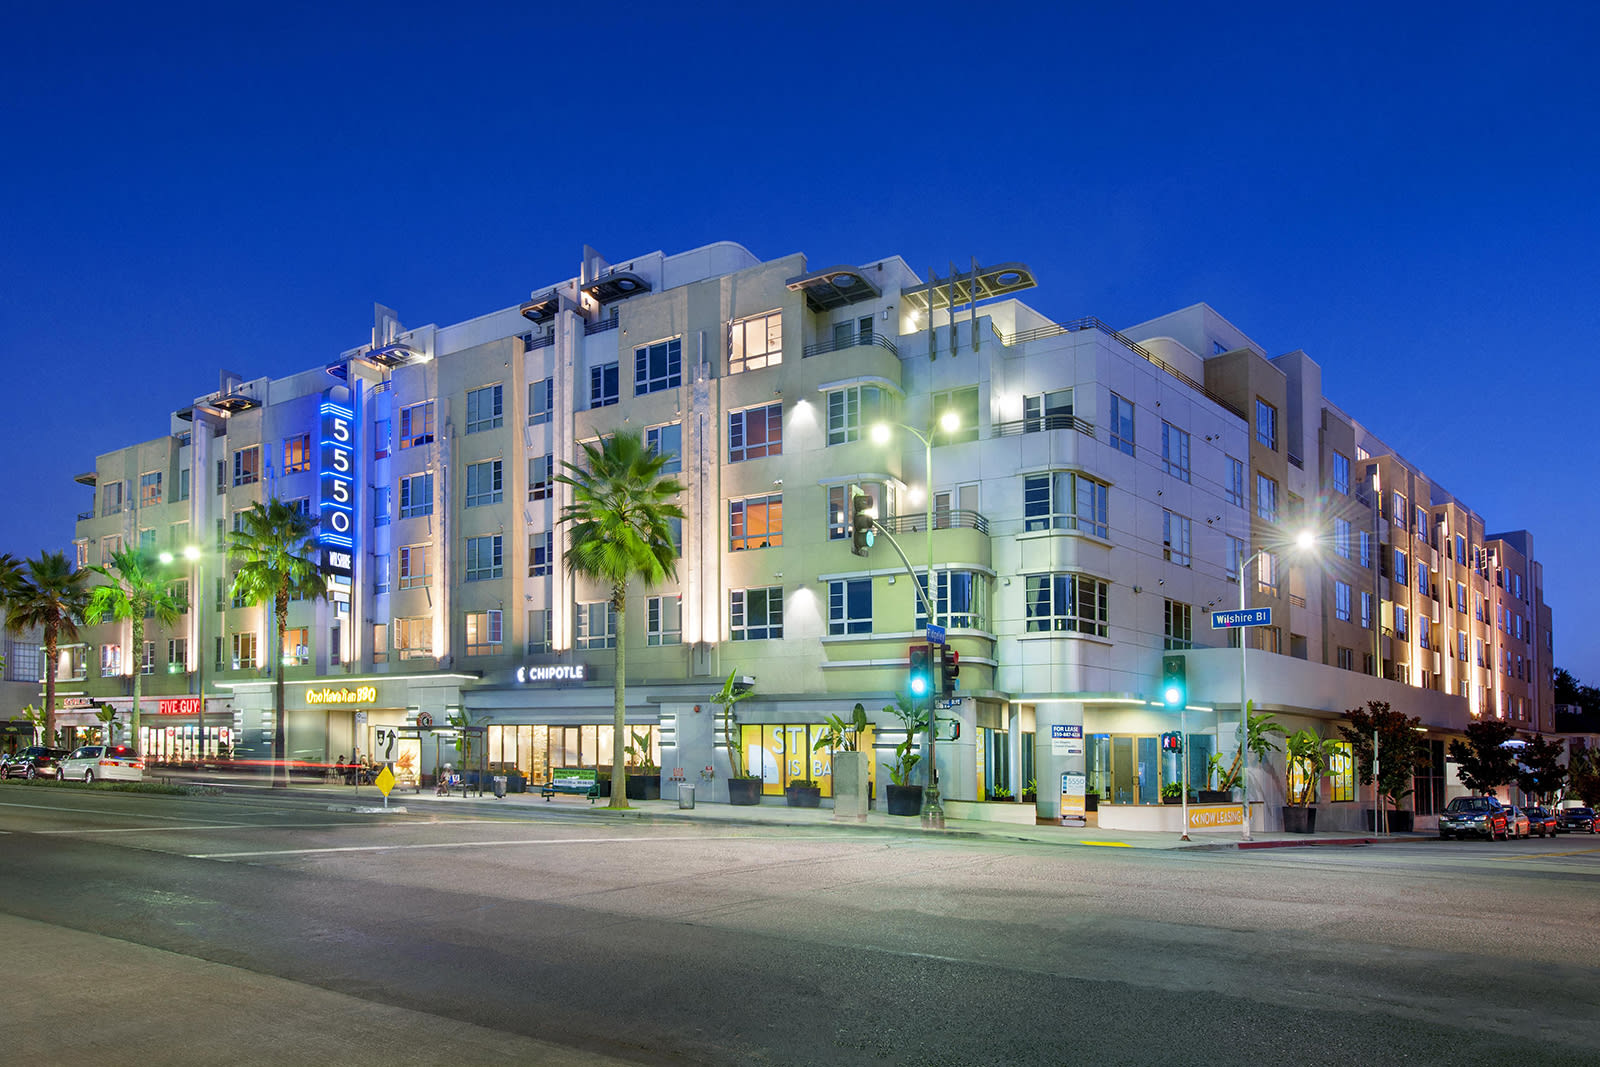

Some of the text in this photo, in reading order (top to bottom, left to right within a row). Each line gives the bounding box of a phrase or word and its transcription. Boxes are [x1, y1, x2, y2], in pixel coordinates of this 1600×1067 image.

[332, 418, 349, 532] 5550
[1217, 612, 1266, 624] Wilshire Bl
[529, 665, 583, 680] CHIPOTLE
[306, 689, 323, 703] Ono
[357, 686, 376, 702] BBQ
[160, 700, 178, 713] FIVE
[788, 760, 800, 776] IS
[1200, 810, 1241, 825] NOW LEASING
